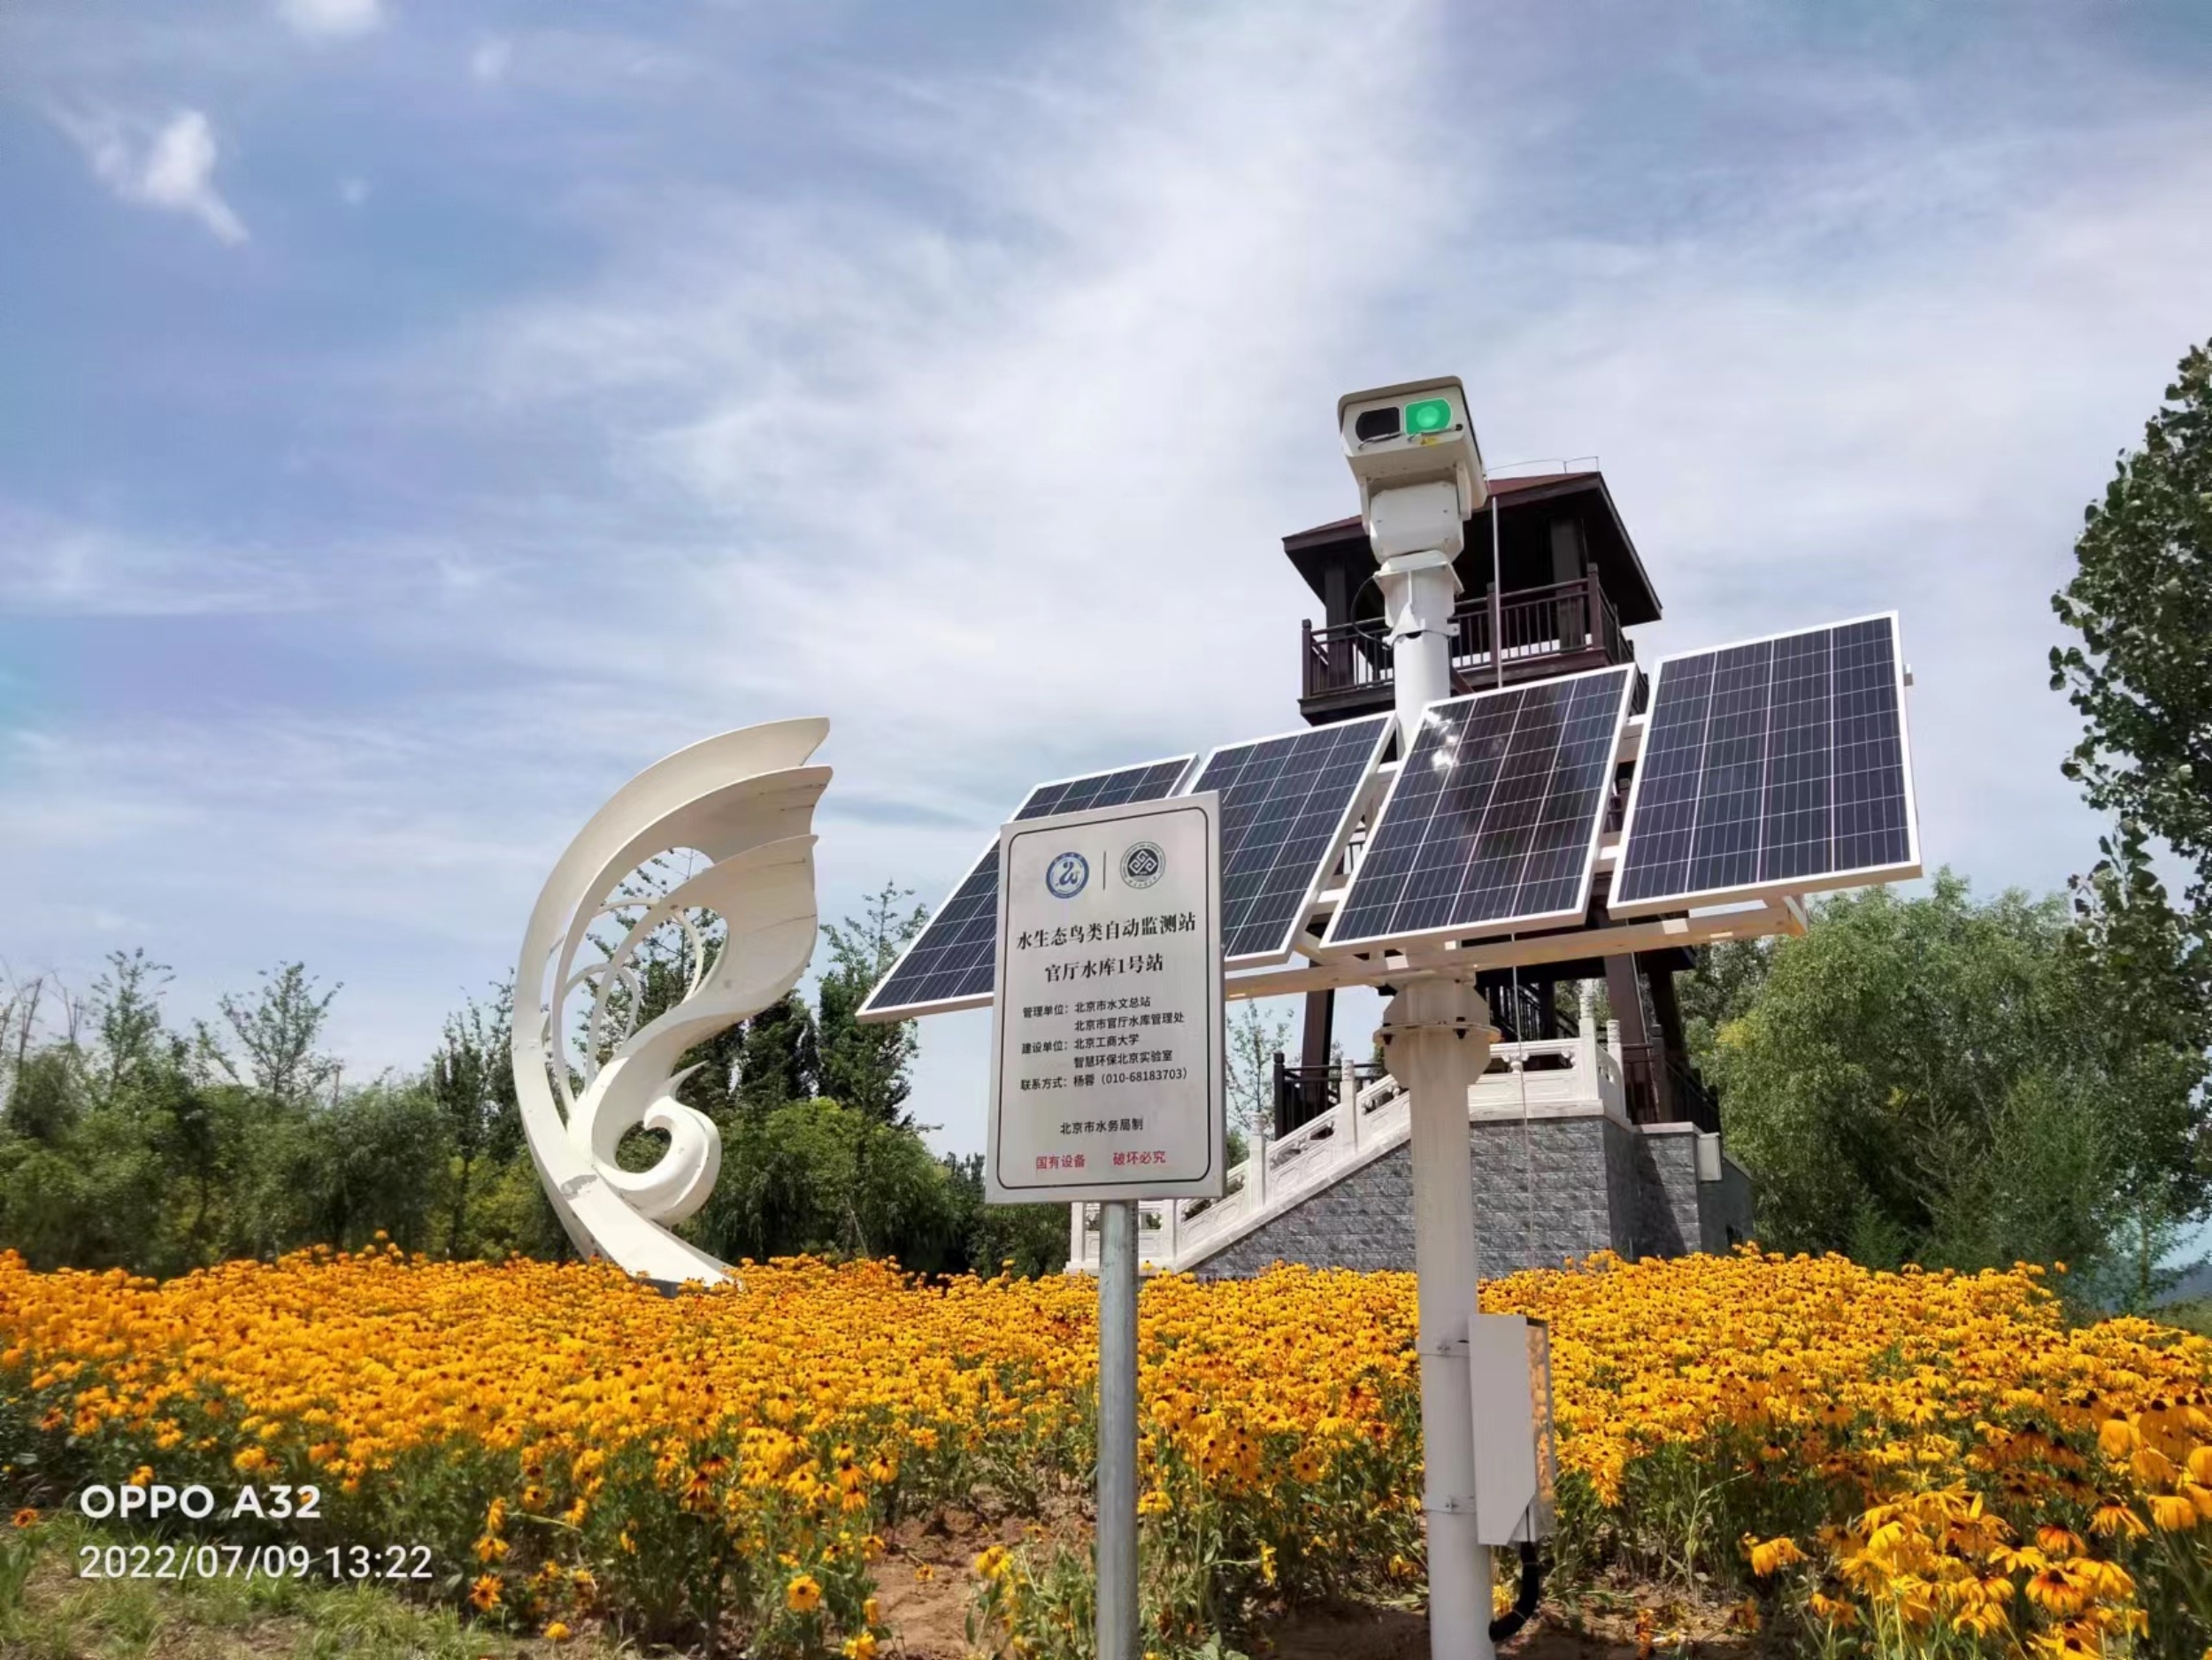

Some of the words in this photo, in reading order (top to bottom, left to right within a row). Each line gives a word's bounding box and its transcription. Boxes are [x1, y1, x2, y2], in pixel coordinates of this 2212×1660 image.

[1017, 912, 1195, 950] 水生态鸟类自动监测站
[1045, 953, 1163, 982] 官厅水库1号站
[1074, 1011, 1185, 1032] 北京市官厅水库管理处
[1073, 1049, 1173, 1069] 智慧环保北京实验室
[1060, 1117, 1144, 1135] 北京市水务局制
[1035, 1154, 1086, 1170] 国有设备
[1113, 1150, 1166, 1166] 破坏必究
